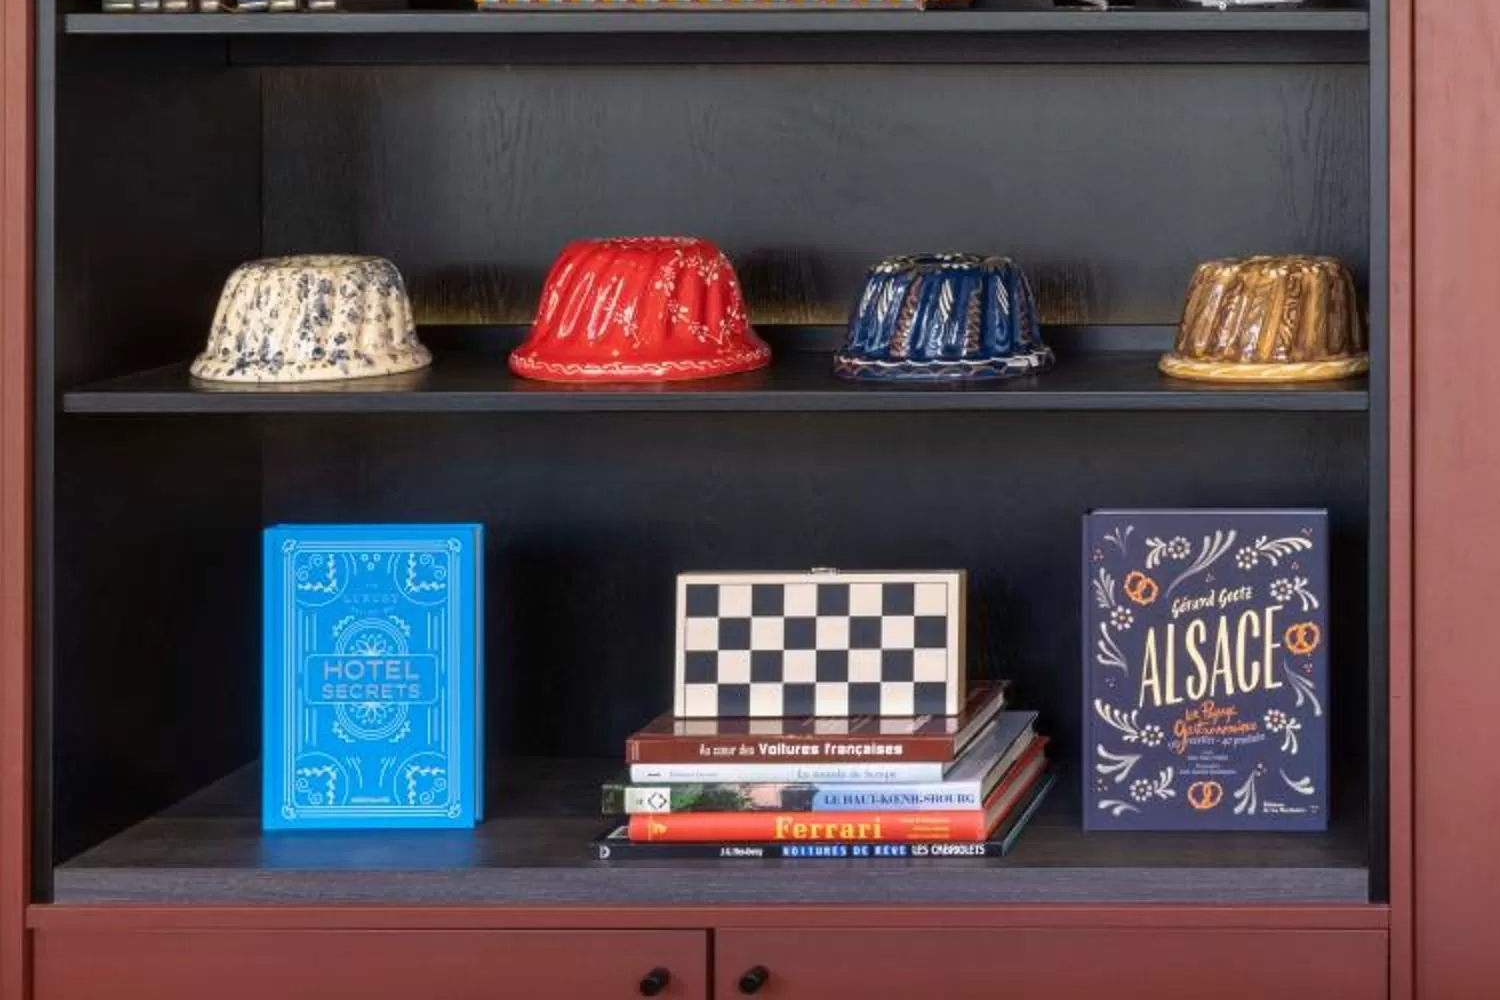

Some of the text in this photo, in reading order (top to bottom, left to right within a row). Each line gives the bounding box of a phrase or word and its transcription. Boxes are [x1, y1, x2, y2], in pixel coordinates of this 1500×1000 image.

[1138, 604, 1284, 708] ALSACE
[323, 660, 419, 681] HOTEL
[322, 684, 419, 699] SECRETS
[758, 743, 820, 756] Voitures
[824, 743, 903, 758] françaises
[775, 815, 883, 840] Ferrari
[782, 845, 847, 857] VOITURES
[912, 844, 928, 856] LES
